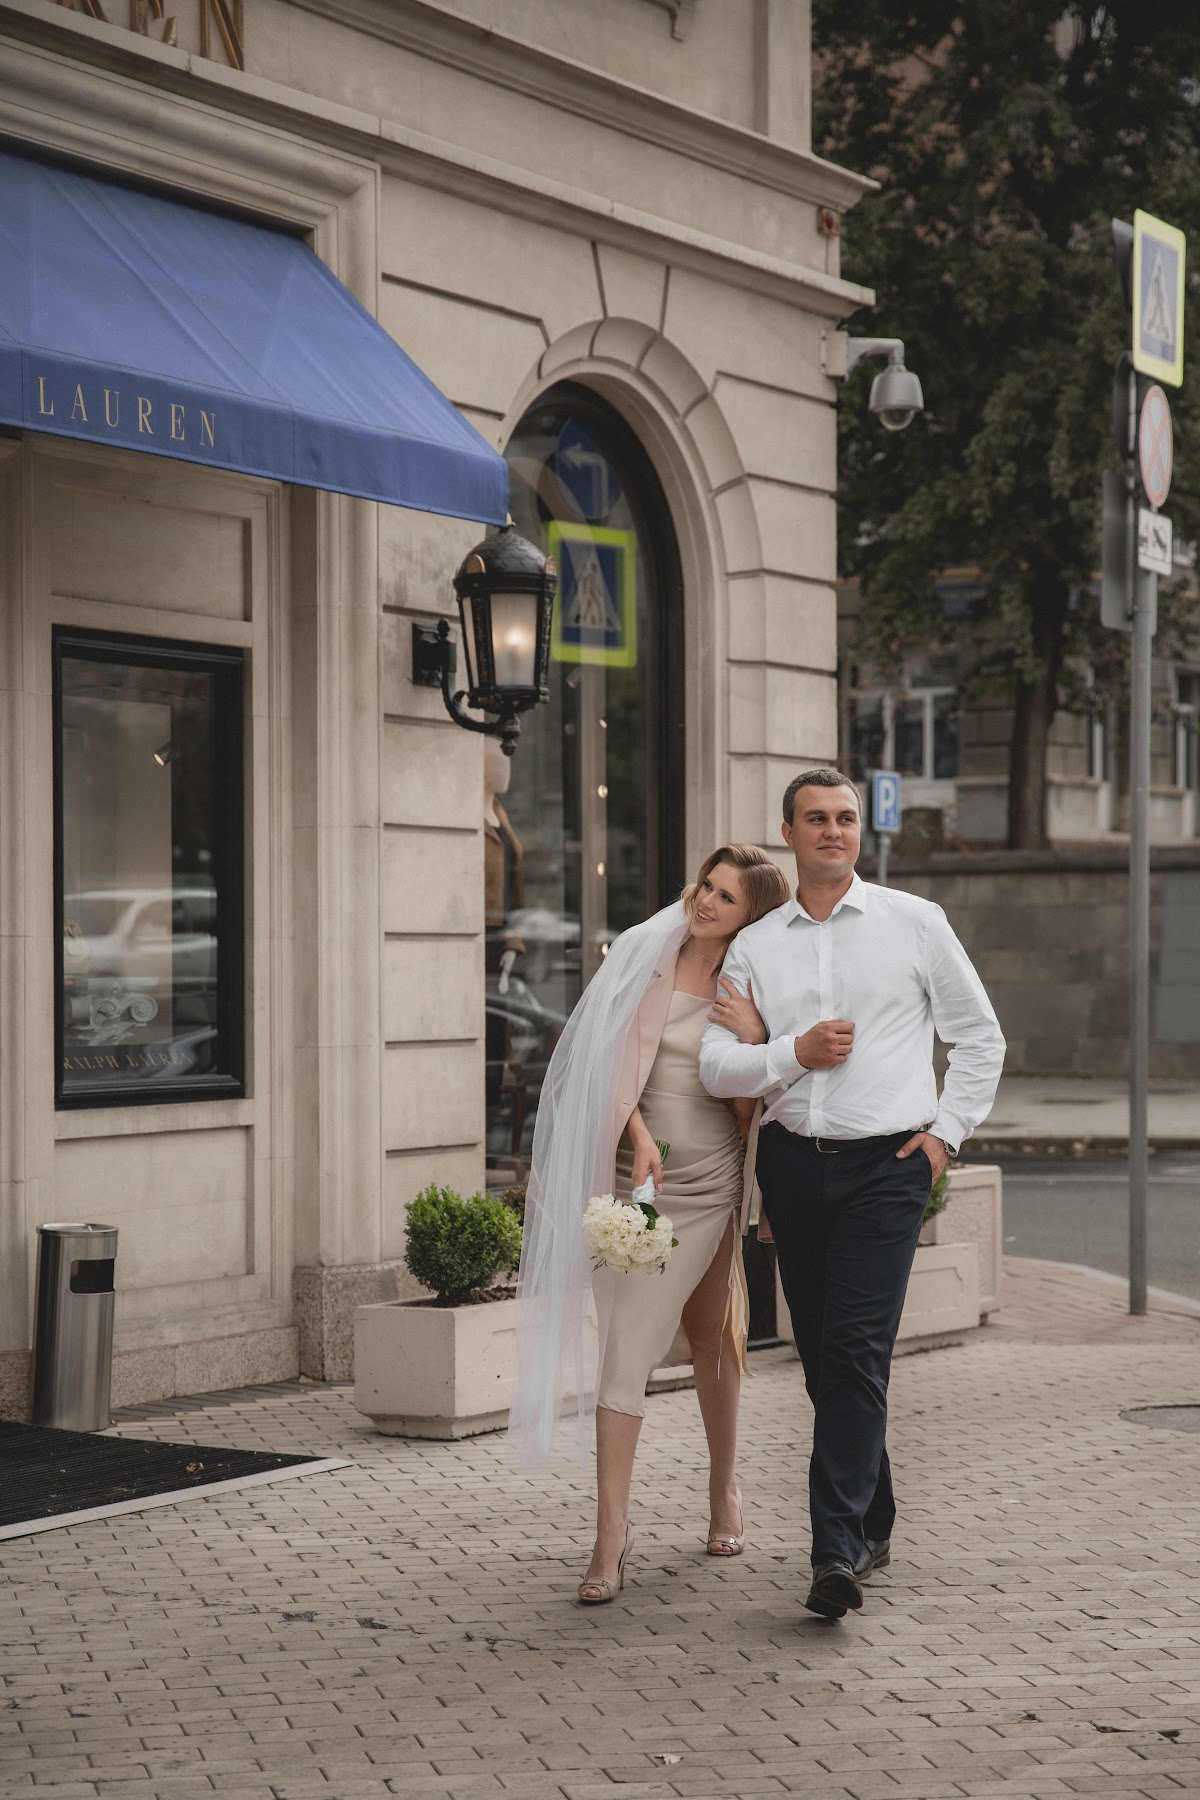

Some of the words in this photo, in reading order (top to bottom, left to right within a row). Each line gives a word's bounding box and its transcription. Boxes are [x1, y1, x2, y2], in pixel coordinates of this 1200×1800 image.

[38, 376, 216, 448] LAUREN
[879, 779, 896, 822] P
[63, 1054, 120, 1071] RALPH
